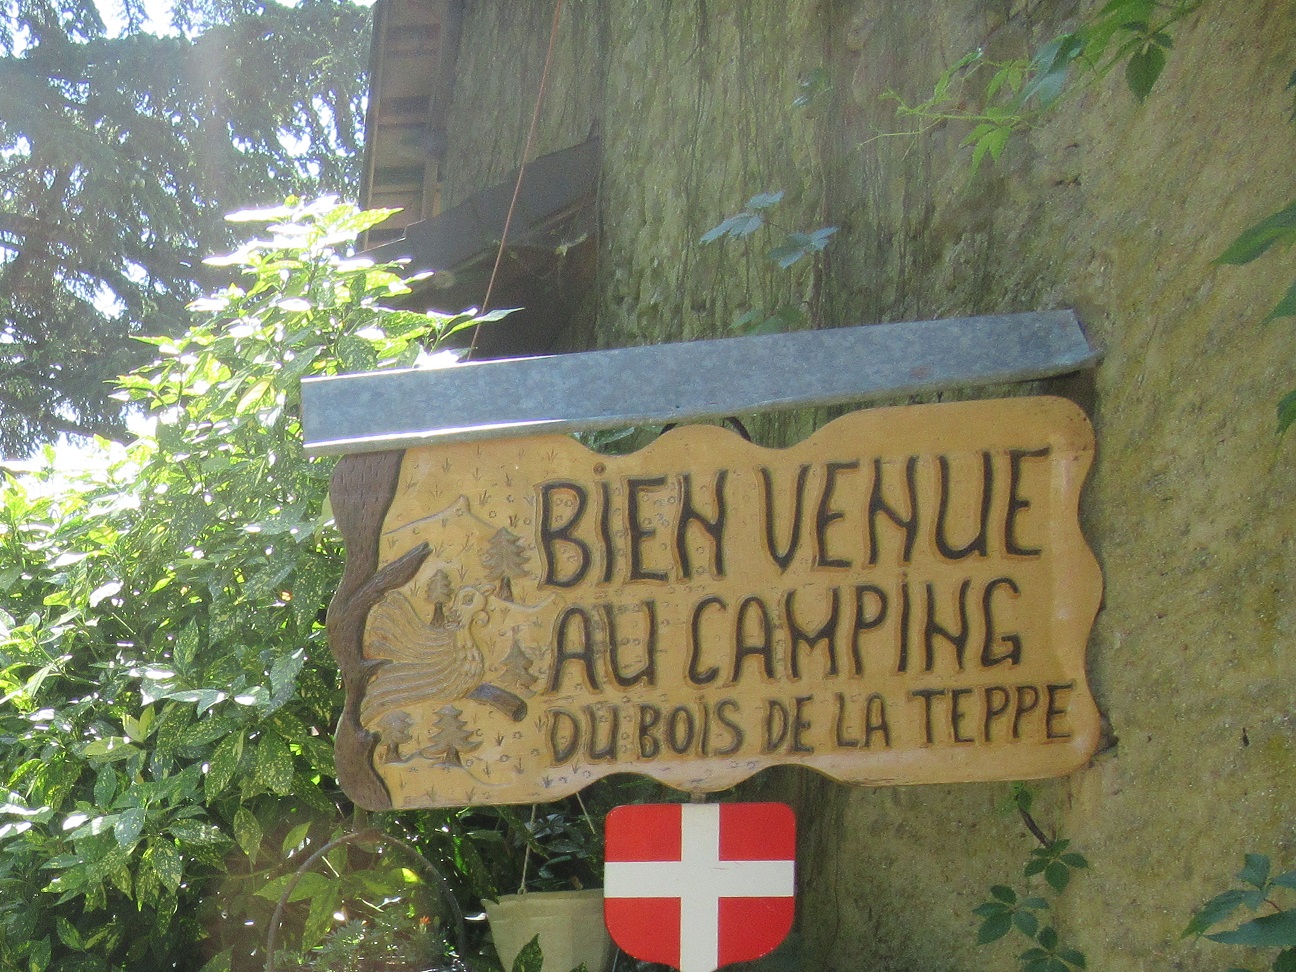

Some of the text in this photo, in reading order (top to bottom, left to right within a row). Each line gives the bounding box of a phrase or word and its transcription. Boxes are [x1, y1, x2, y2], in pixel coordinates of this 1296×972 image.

[548, 572, 1024, 696] AU CAMPING
[549, 681, 1076, 766] DU BOIS DE LA TEPPE
